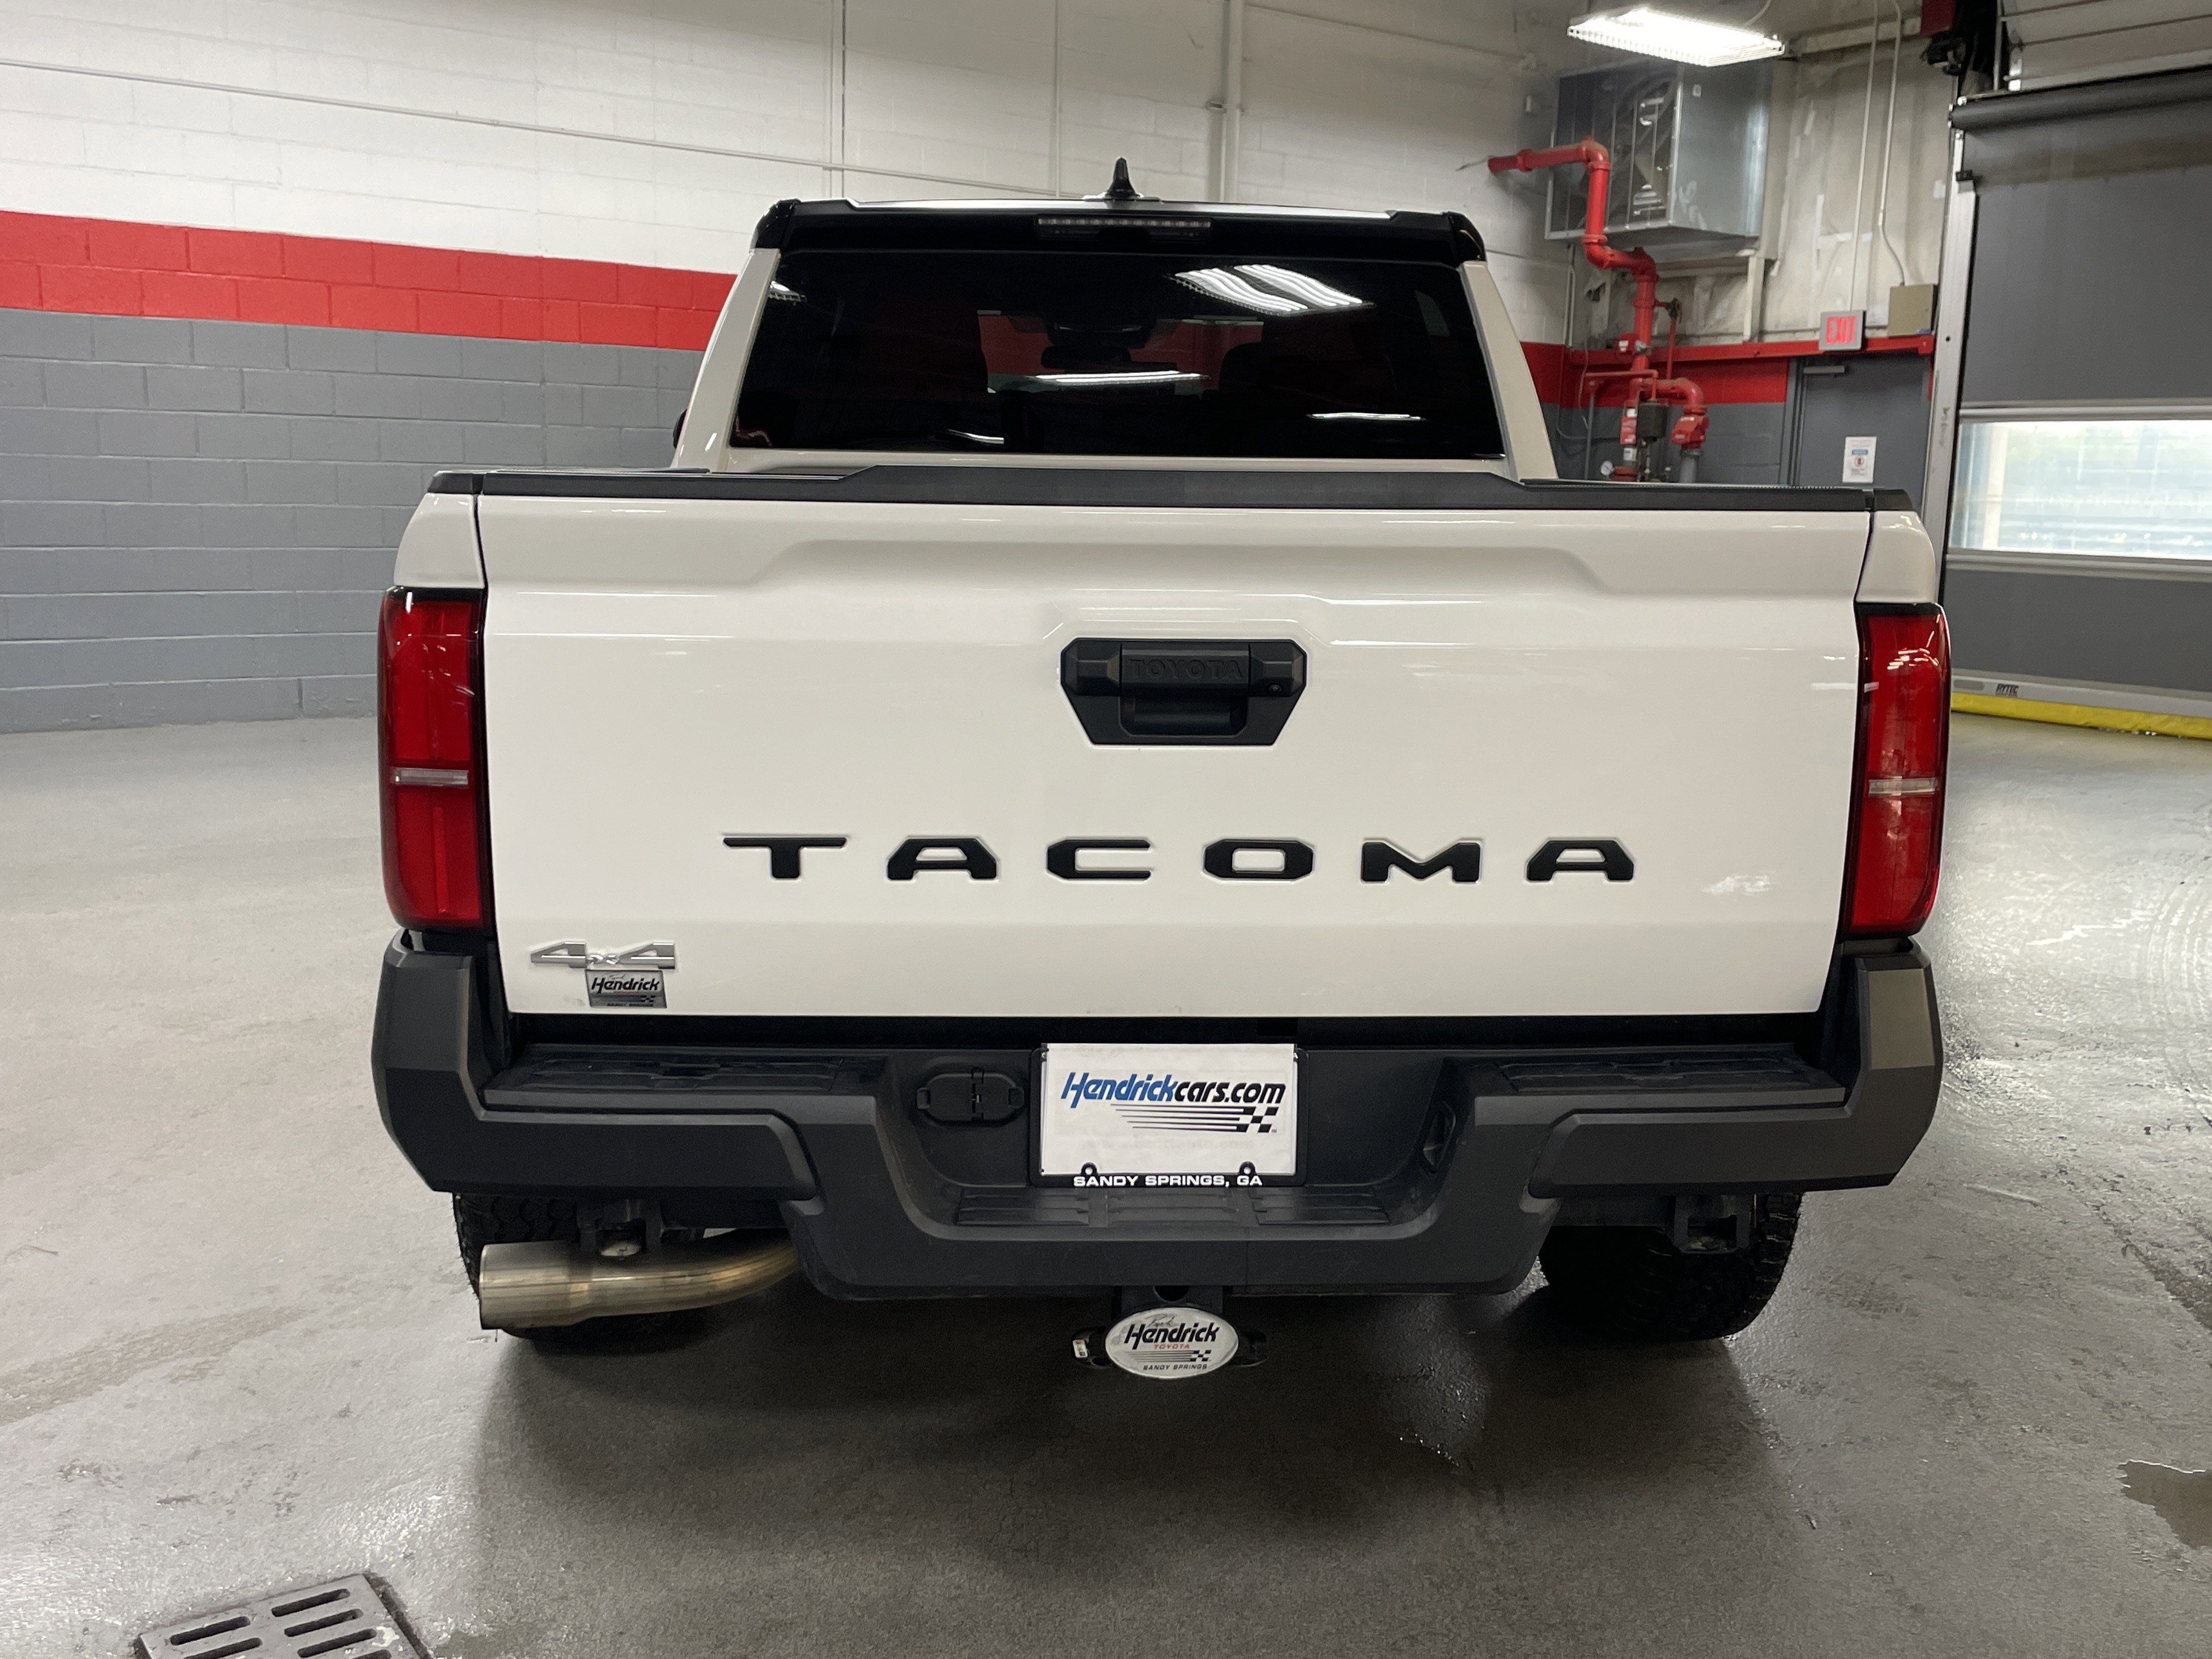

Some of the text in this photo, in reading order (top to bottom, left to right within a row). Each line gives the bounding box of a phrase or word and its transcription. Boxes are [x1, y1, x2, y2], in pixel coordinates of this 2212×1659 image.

[1826, 315, 1857, 344] EXIT
[1128, 658, 1244, 679] TOYOTA
[723, 837, 1634, 882] TACOMA
[591, 977, 659, 994] Hendrick
[1061, 1072, 1286, 1108] Hendrickcars.com
[1074, 1175, 1262, 1188] SANDY SPRINGS, GA
[1124, 1322, 1220, 1350] Hendrick
